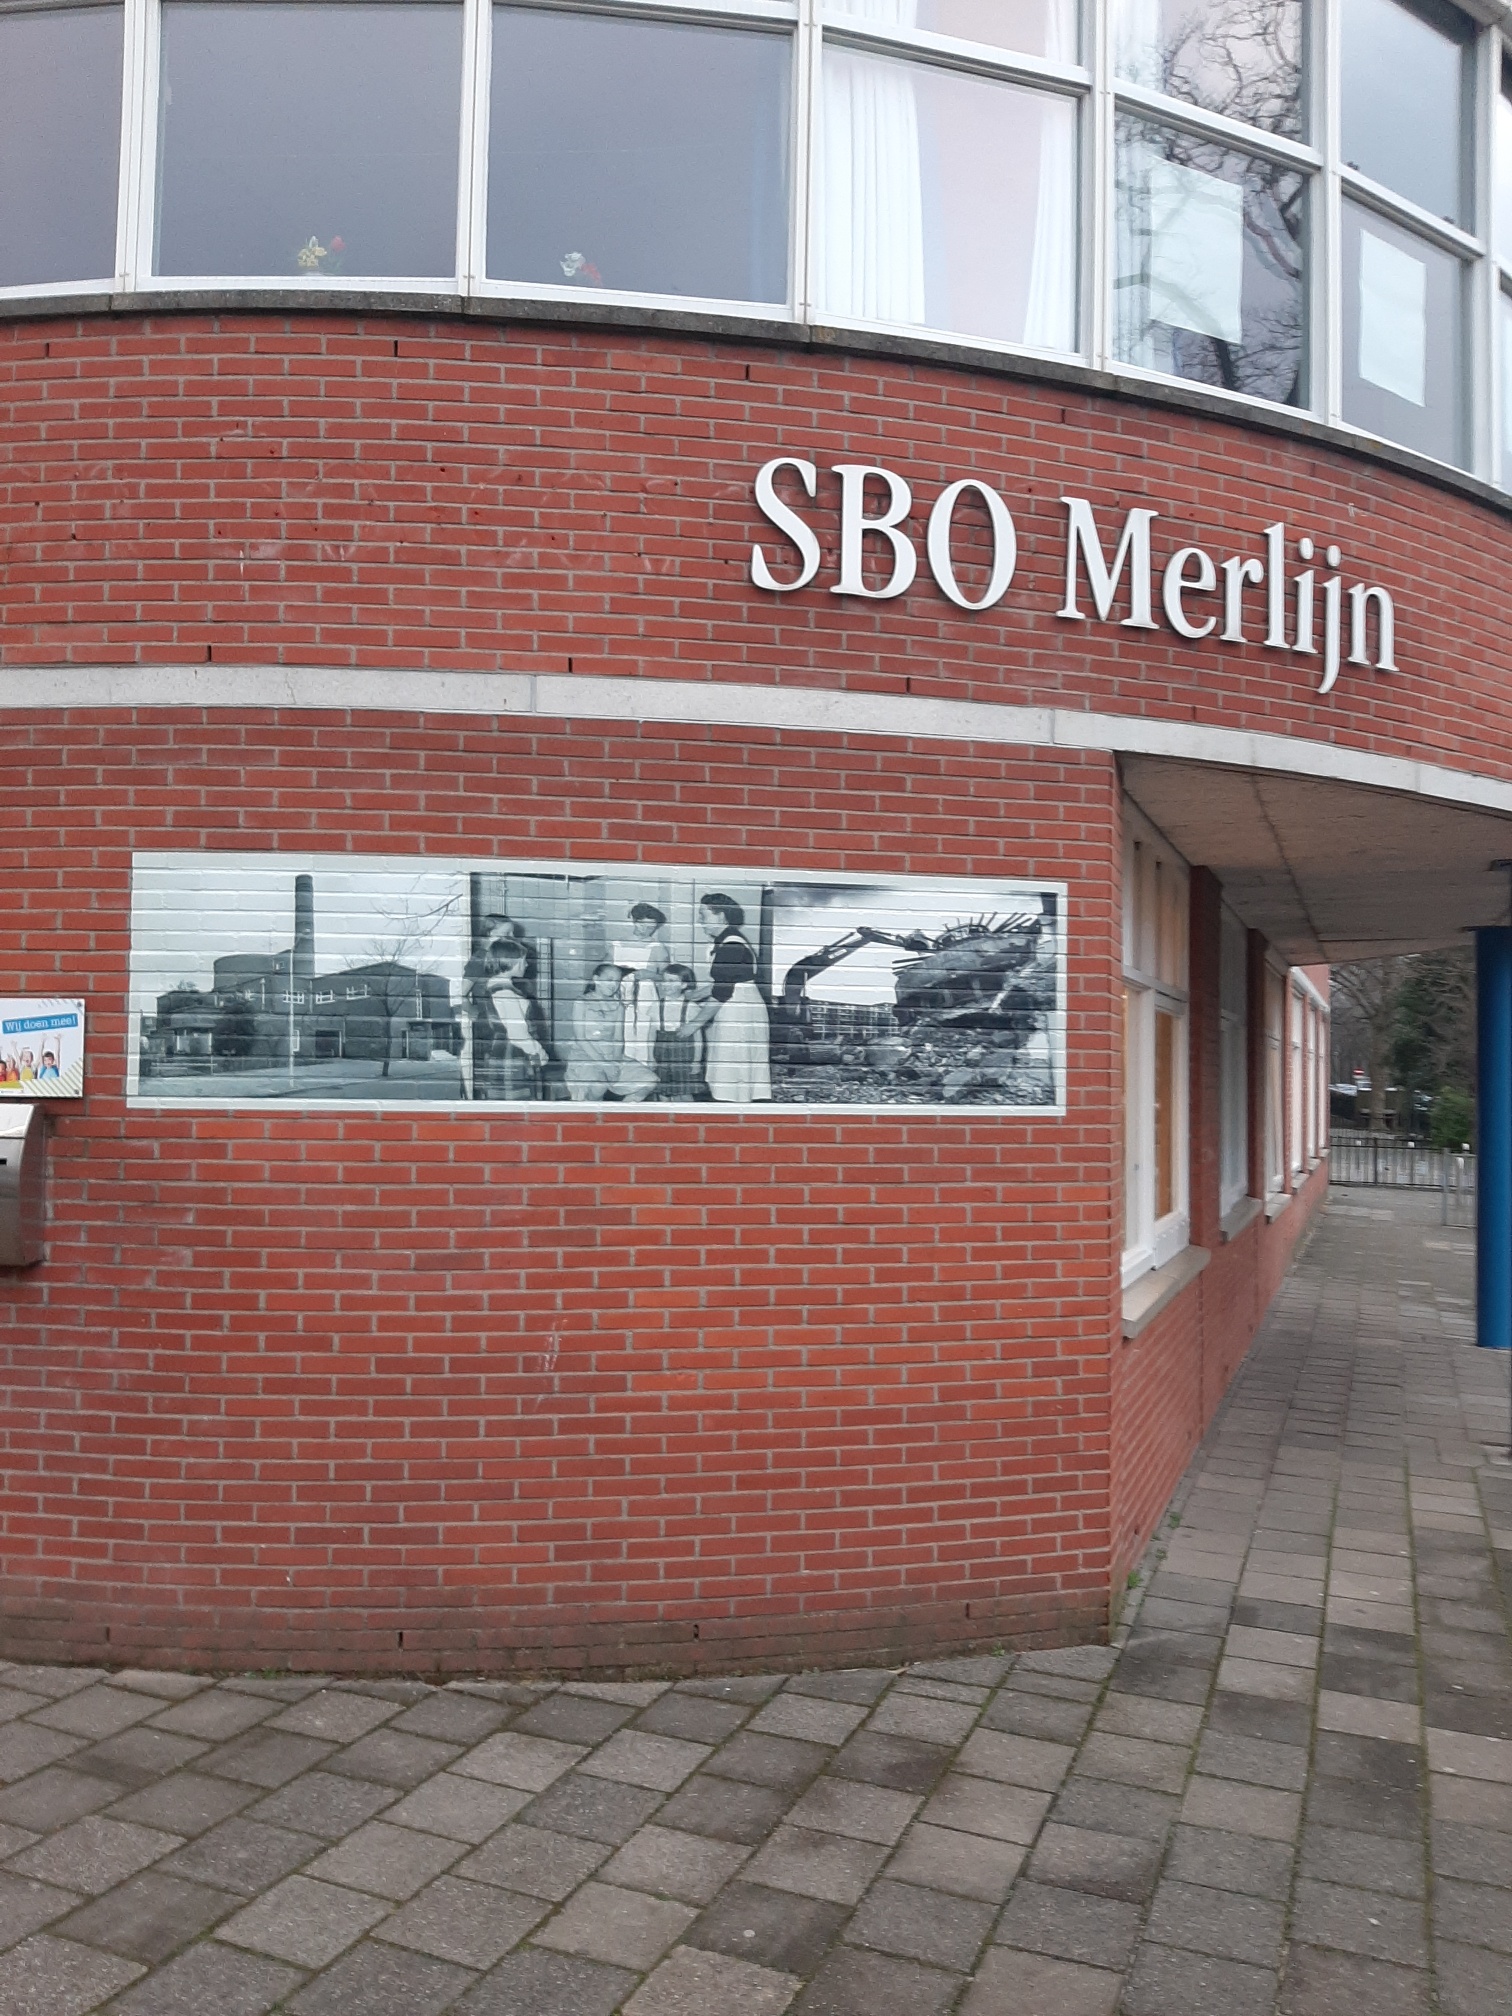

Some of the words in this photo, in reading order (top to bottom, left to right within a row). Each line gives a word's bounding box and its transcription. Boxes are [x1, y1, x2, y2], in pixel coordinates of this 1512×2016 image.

[750, 457, 1018, 611] SBO
[1055, 496, 1399, 694] Merlijn
[5, 1021, 21, 1032] Wij
[23, 1019, 49, 1030] doen
[50, 1016, 76, 1027] mee!
